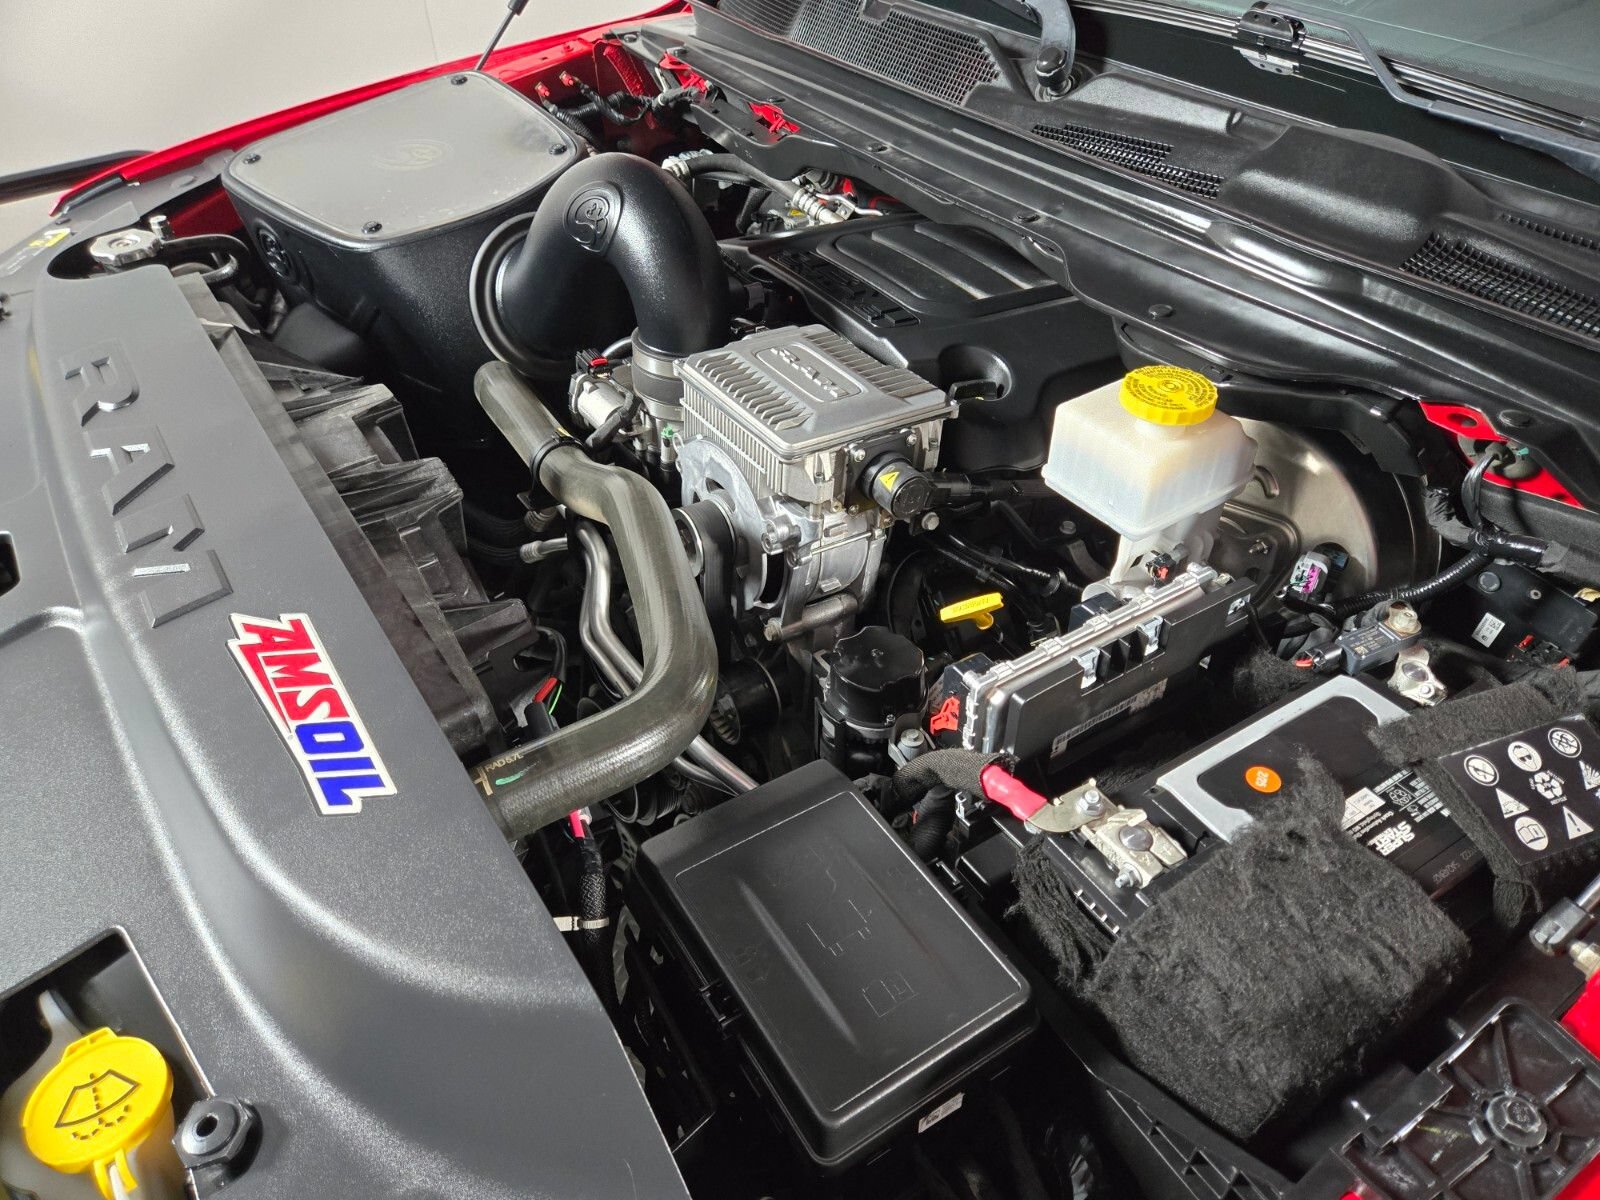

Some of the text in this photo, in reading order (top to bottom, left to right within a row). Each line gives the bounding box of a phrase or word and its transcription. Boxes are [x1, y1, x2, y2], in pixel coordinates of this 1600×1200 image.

[59, 338, 234, 628] RAM
[237, 618, 387, 806] AMSOIL
[485, 757, 505, 772] RAD
[1374, 821, 1411, 849] START
[1377, 830, 1415, 856] SUPER
